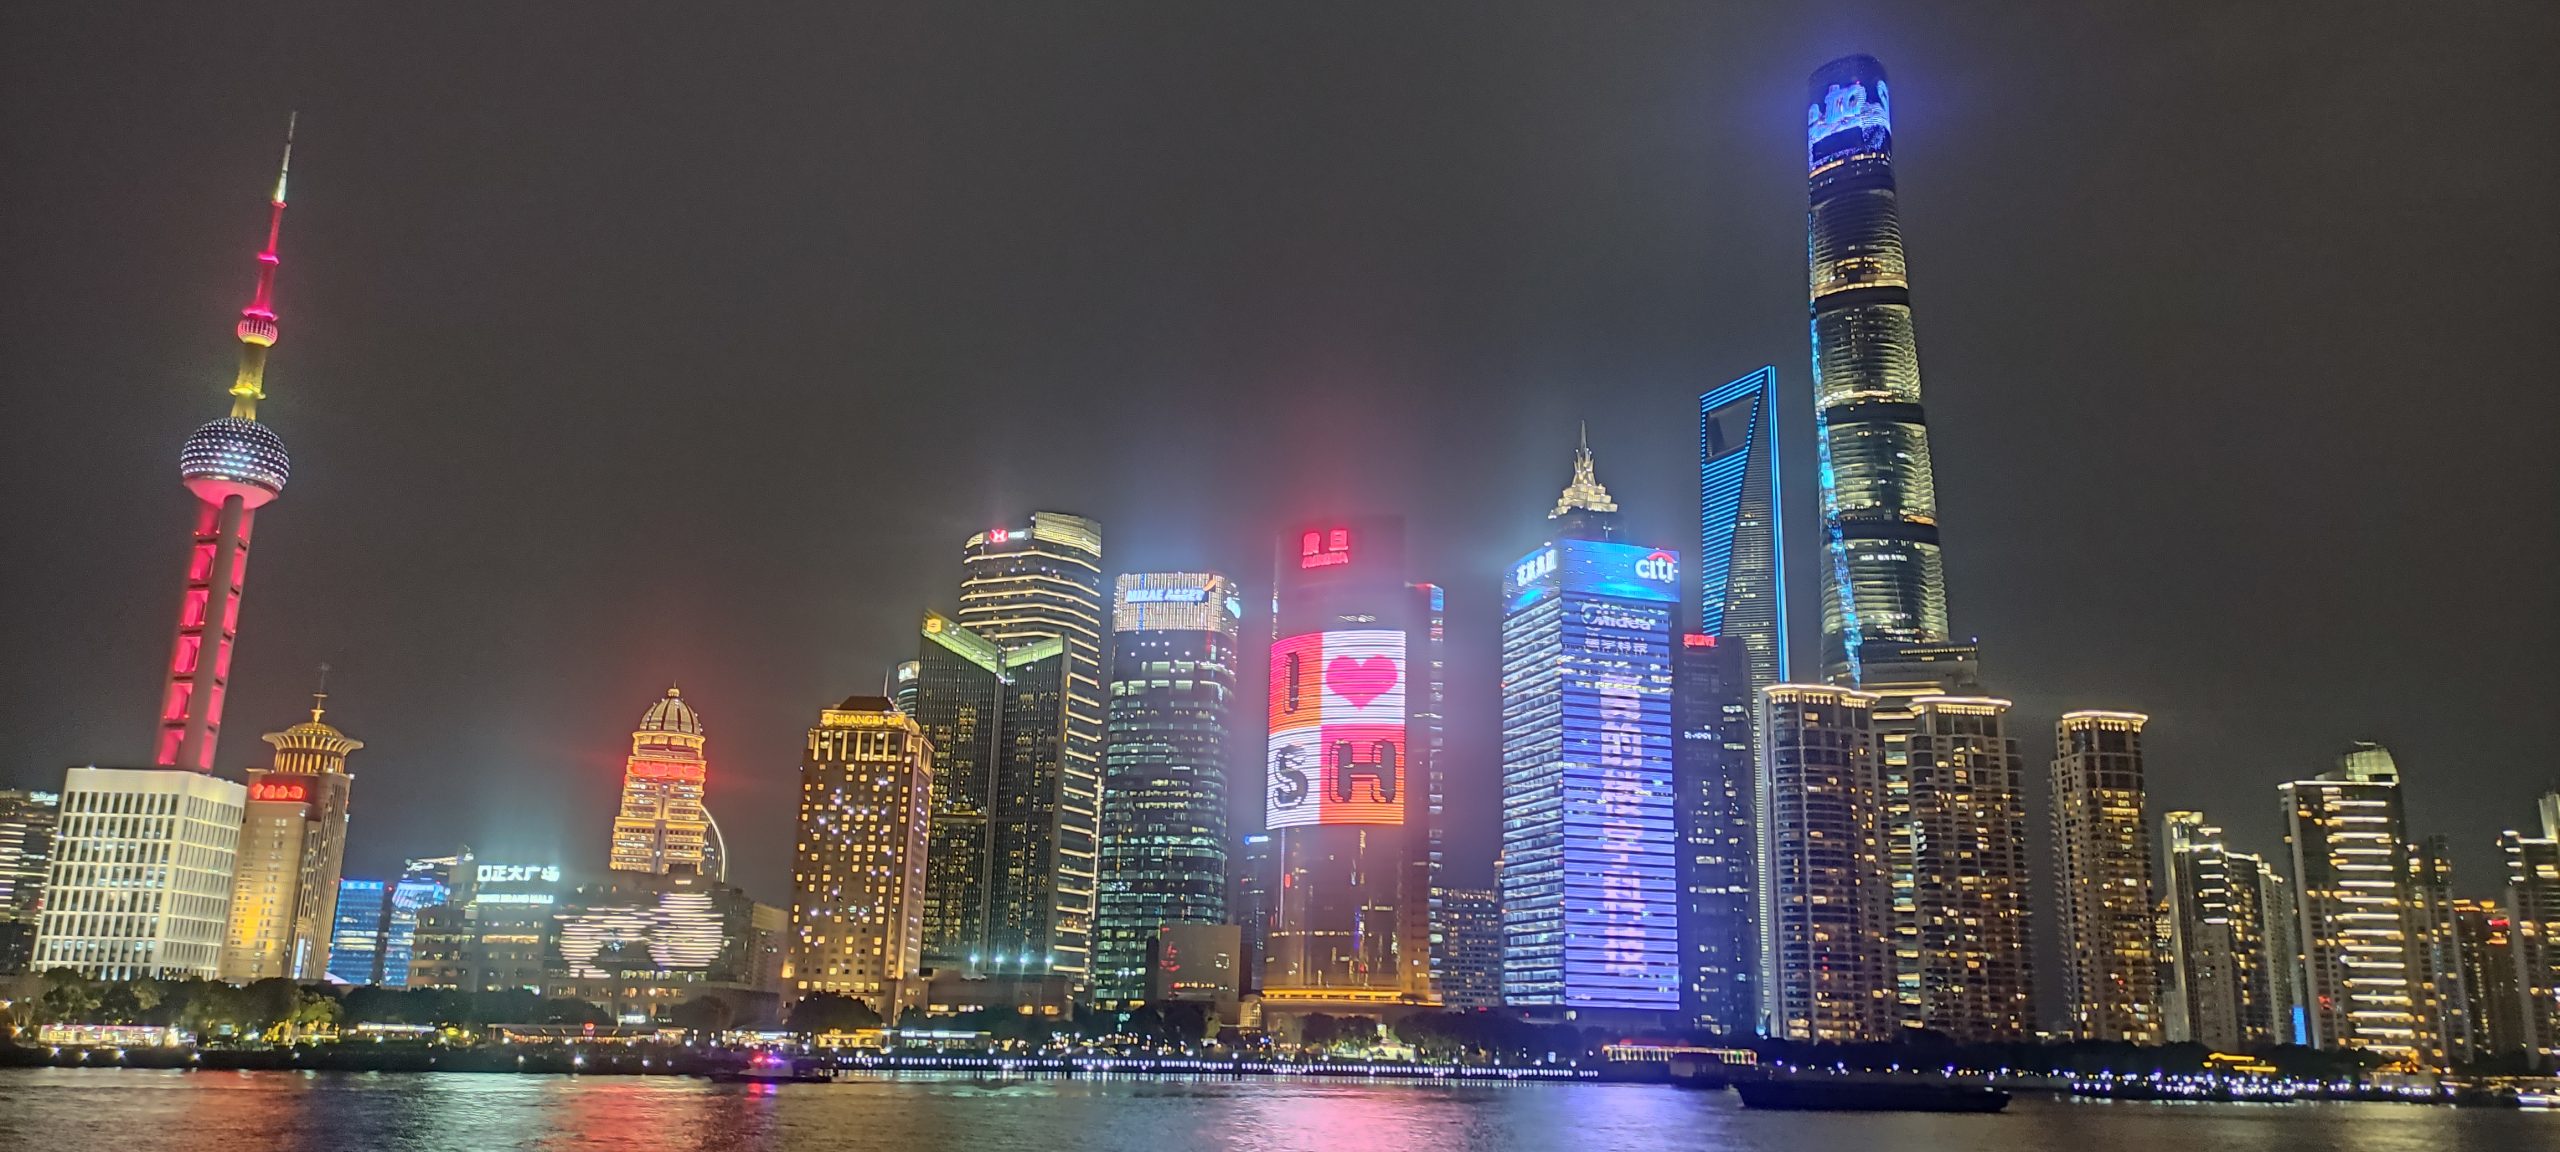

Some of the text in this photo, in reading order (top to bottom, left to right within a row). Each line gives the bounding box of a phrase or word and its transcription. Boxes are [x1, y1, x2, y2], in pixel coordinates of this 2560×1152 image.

[1636, 554, 1676, 582] citi
[491, 865, 560, 882] 正大广场
